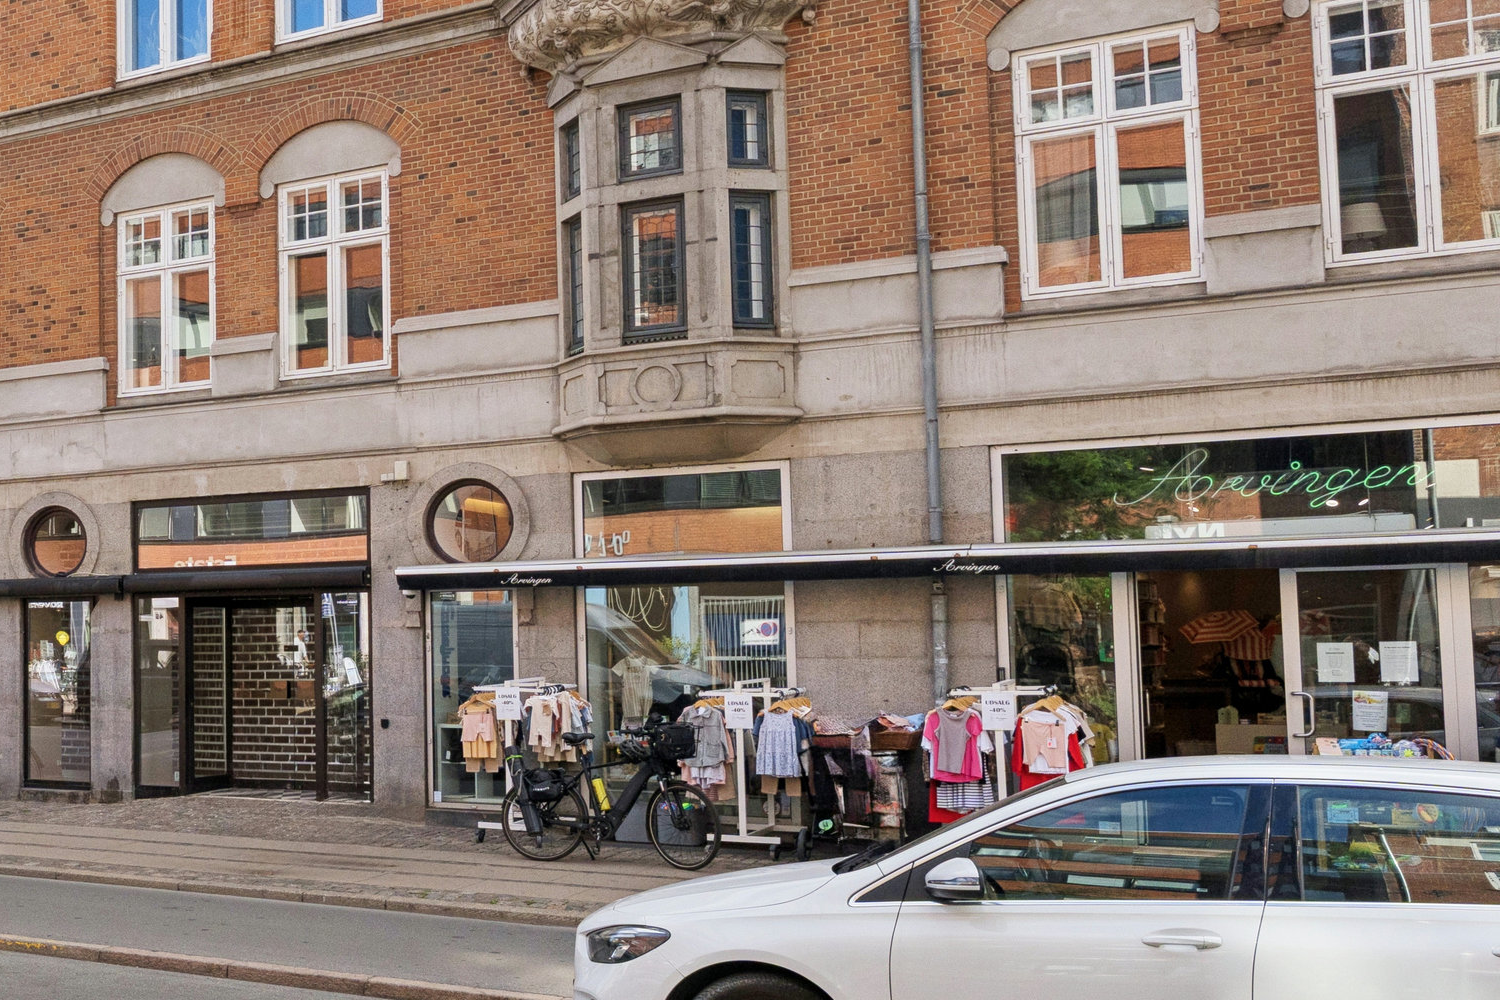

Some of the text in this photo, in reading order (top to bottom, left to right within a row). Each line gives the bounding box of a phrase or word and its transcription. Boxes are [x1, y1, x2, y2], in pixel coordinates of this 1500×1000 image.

[1113, 448, 1436, 508] Arvingen
[932, 558, 1001, 575] Arvingen
[500, 573, 552, 587] Arvingen
